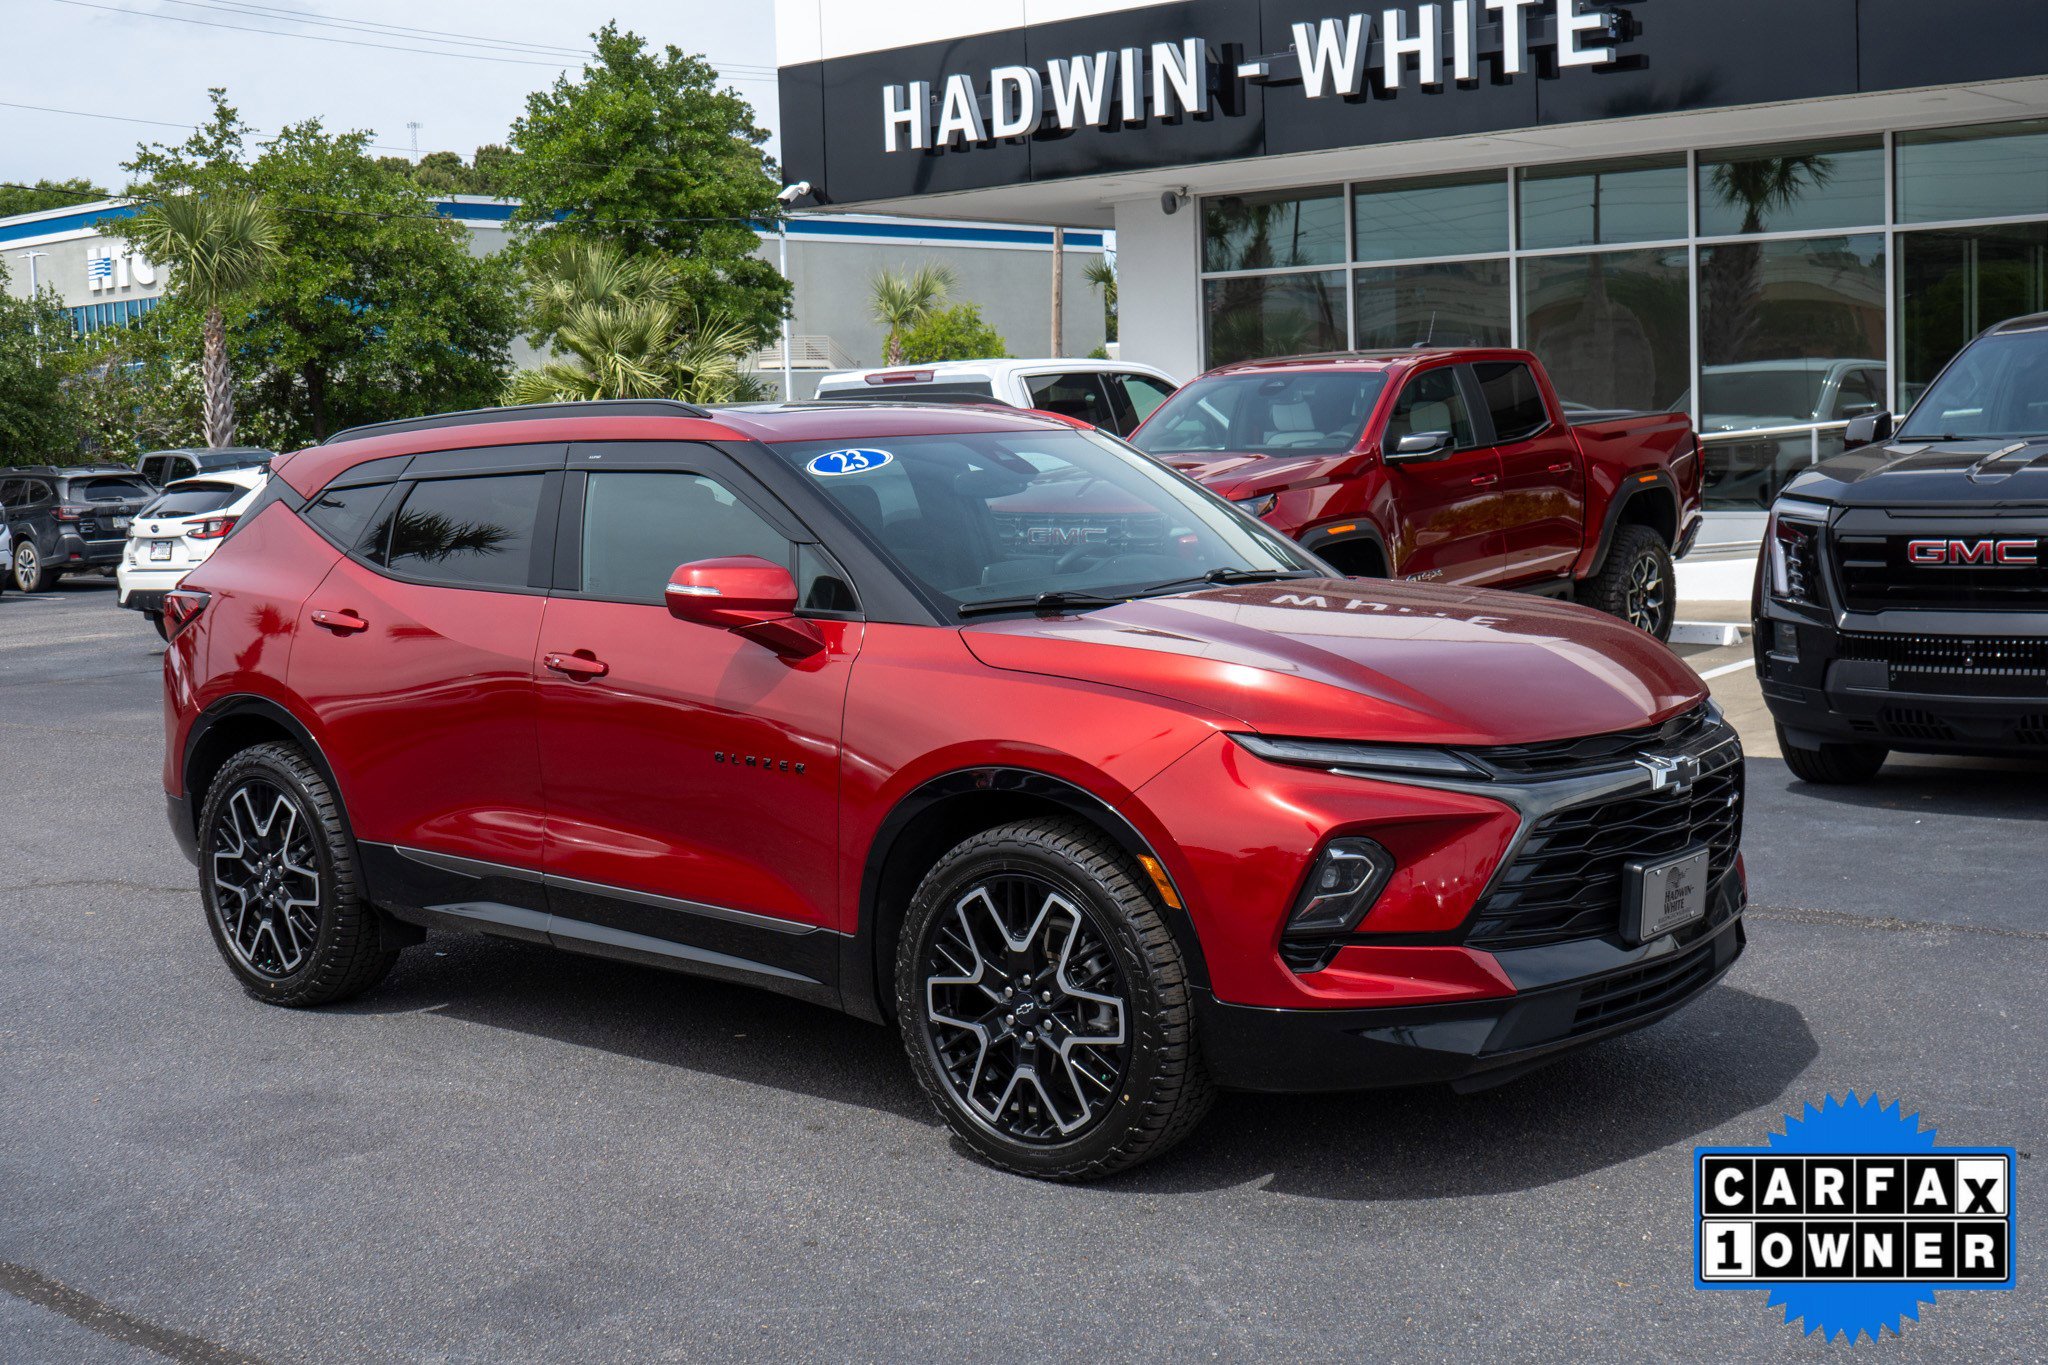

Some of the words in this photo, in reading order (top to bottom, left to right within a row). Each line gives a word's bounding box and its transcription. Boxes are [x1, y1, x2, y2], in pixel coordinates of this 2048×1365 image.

[883, 37, 1206, 152] HADWIN
[1292, 0, 1616, 99] WHITE
[829, 450, 869, 472] 23
[1027, 526, 1107, 545] GMC
[1907, 540, 2038, 564] GMC
[714, 751, 805, 774] BLAZER
[1663, 898, 1685, 915] WHITE
